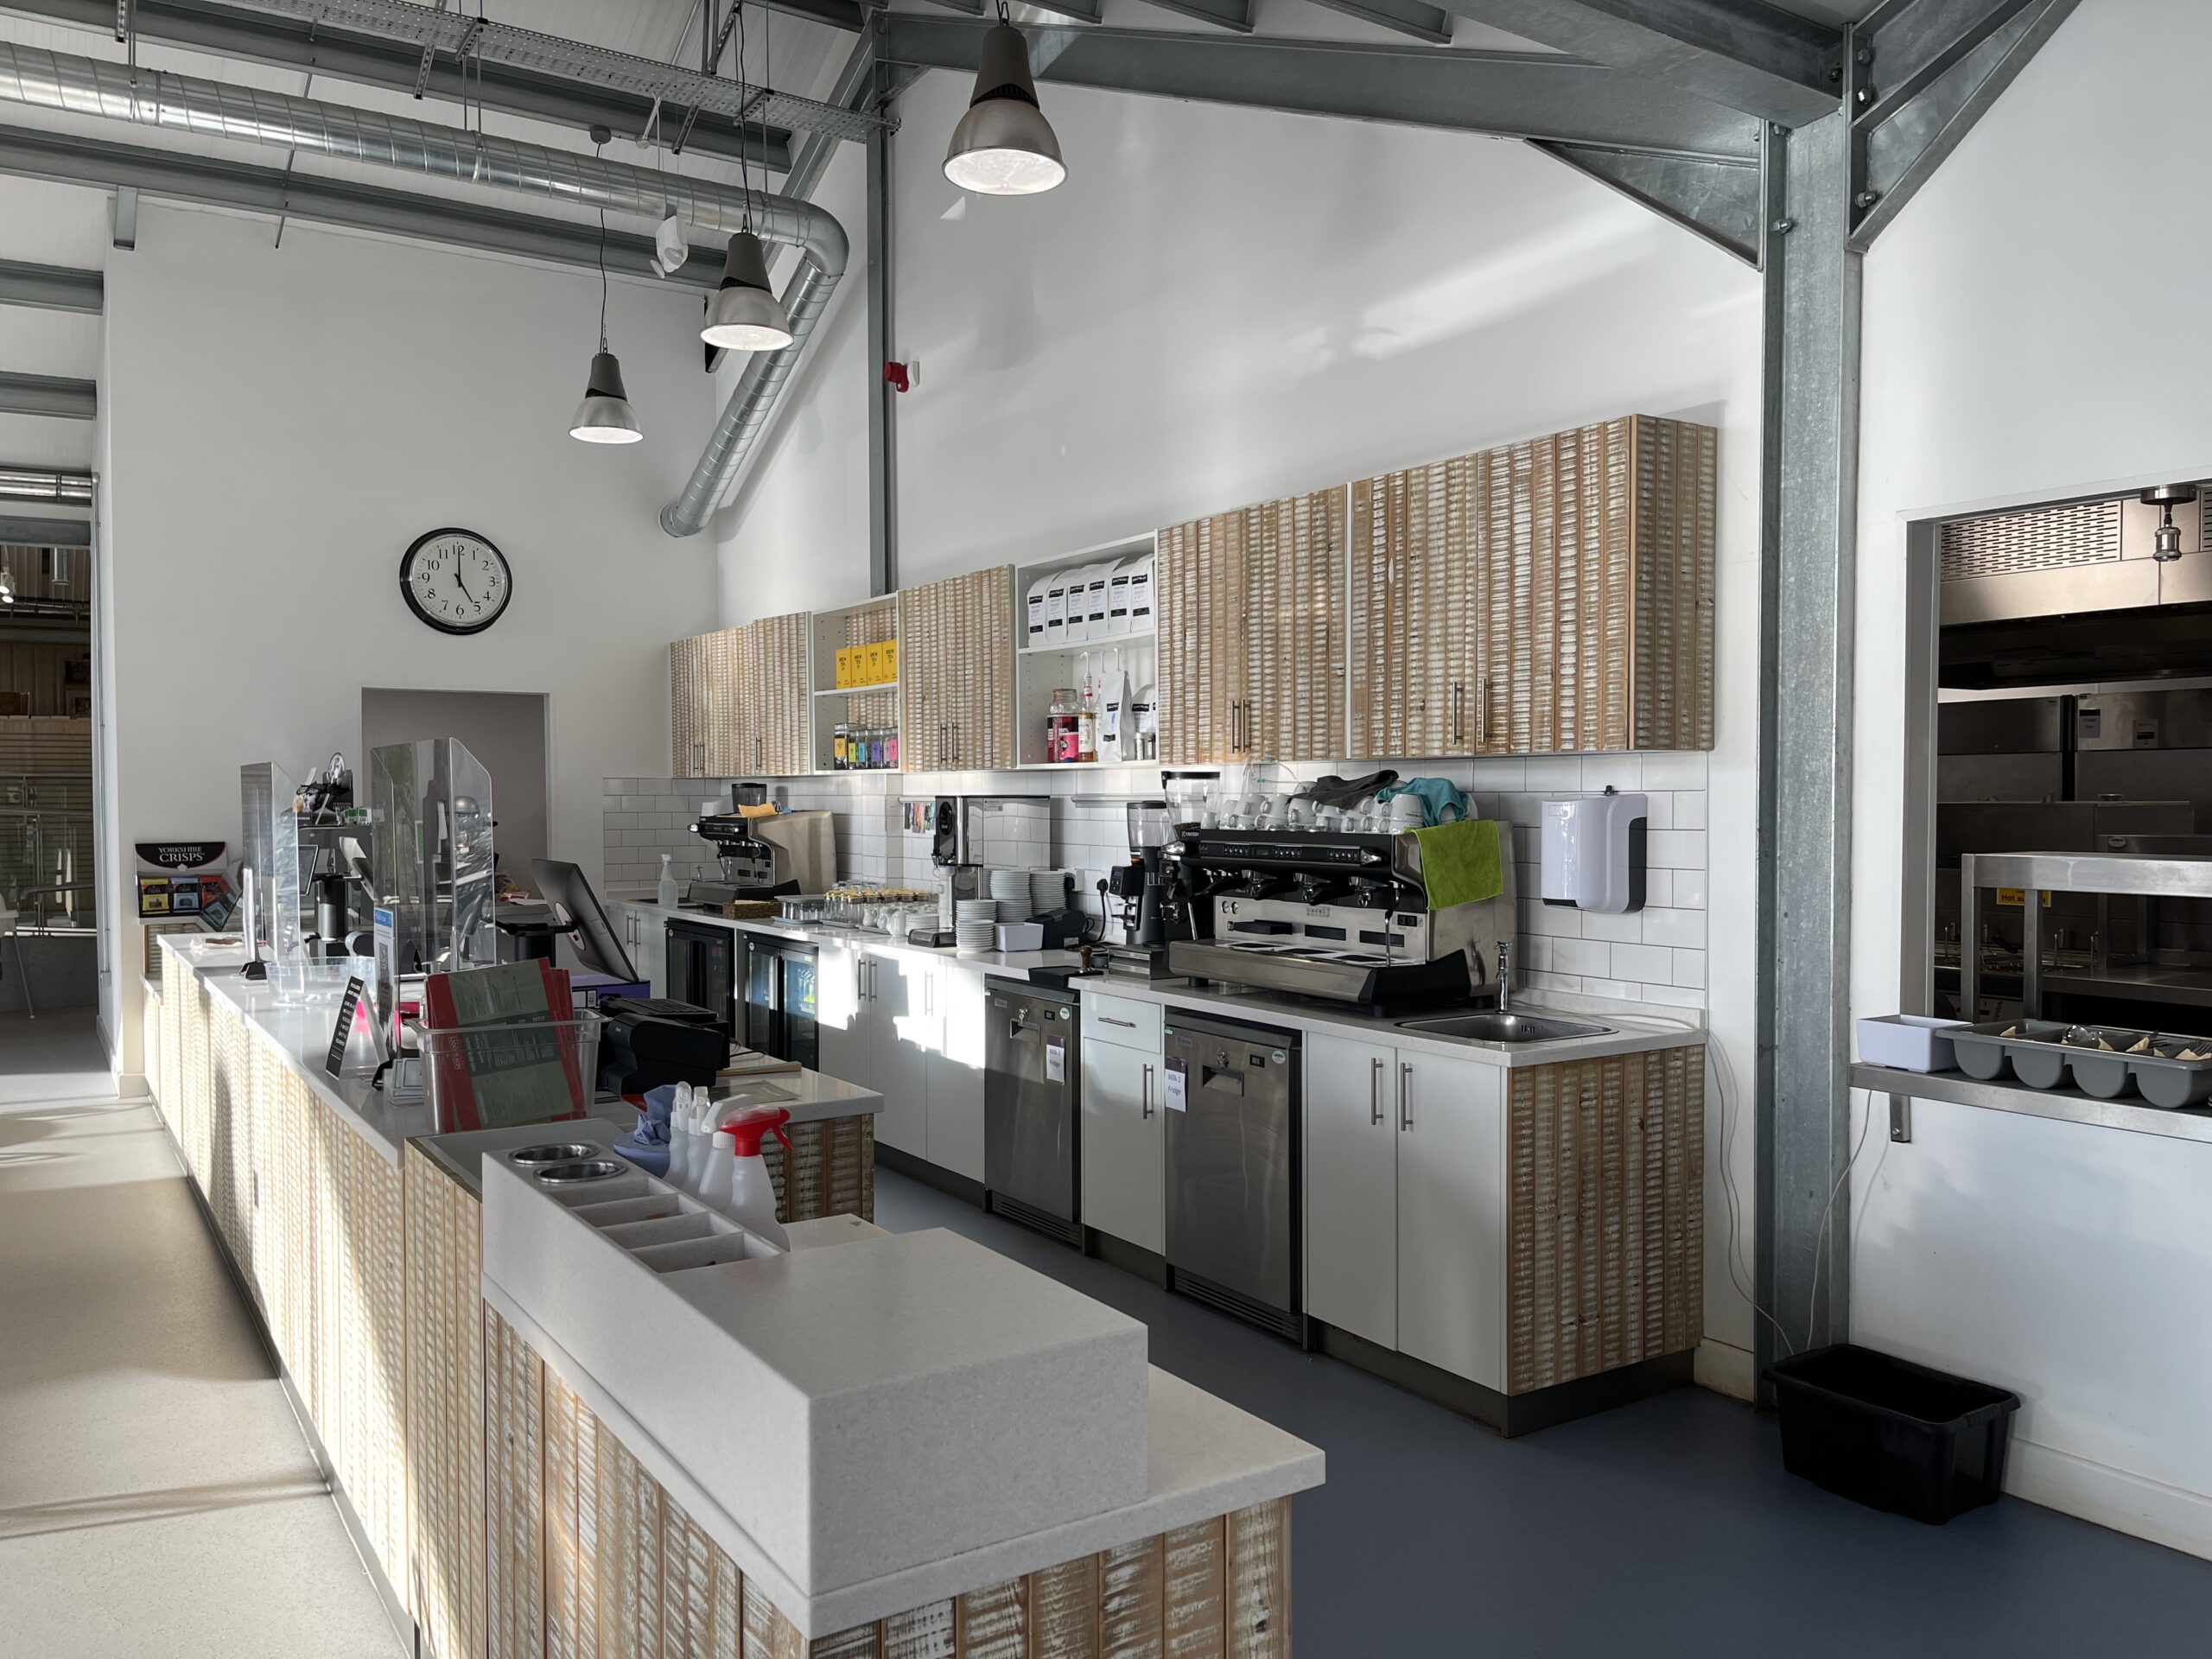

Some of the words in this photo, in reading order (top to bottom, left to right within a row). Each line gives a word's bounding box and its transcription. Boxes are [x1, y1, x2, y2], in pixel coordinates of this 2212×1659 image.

[439, 550, 448, 559] 11
[452, 545, 465, 556] 12
[472, 550, 476, 561] 1
[427, 560, 440, 571] 10
[481, 561, 489, 570] 2
[422, 572, 430, 583] 9
[489, 576, 496, 587] 3
[427, 588, 435, 599] 8
[483, 591, 491, 601] 4
[442, 601, 448, 610] 7
[455, 605, 464, 616] 6
[474, 601, 481, 612] 5
[159, 853, 203, 862] CRISPS
